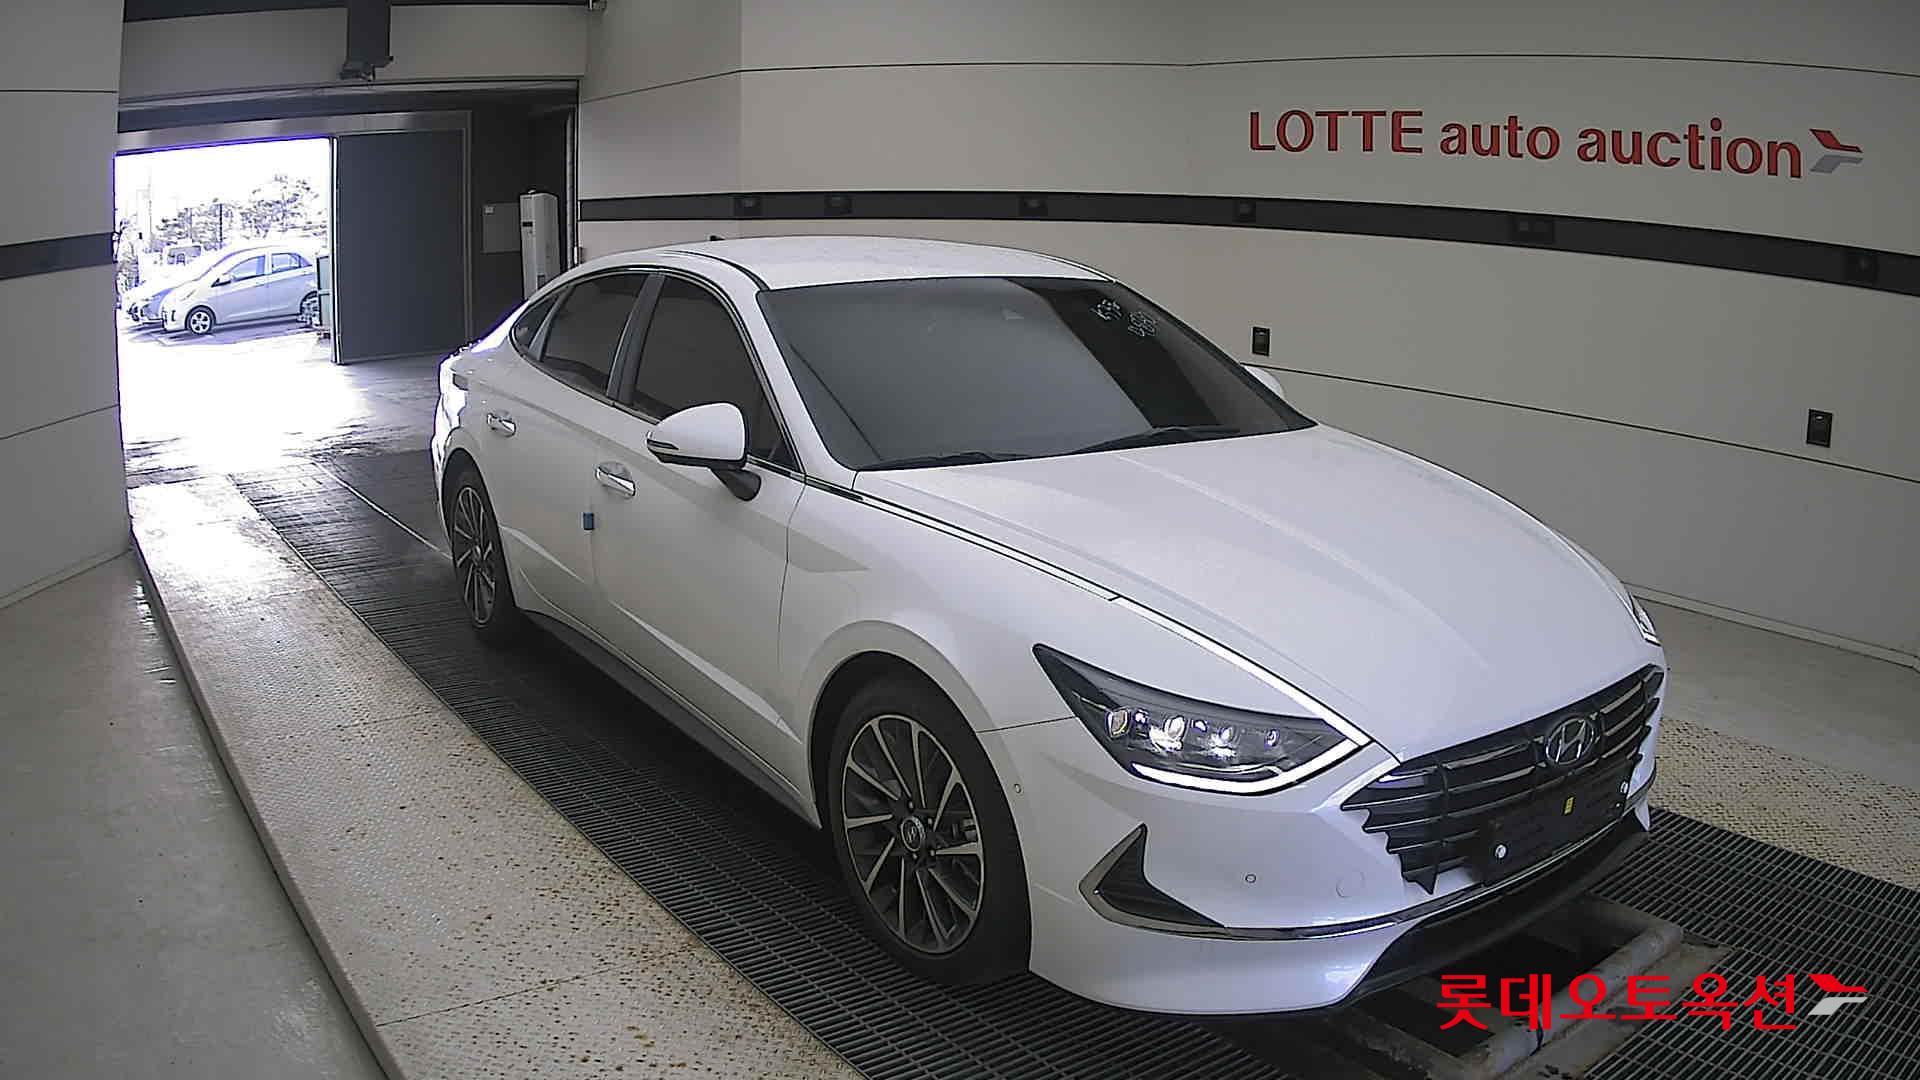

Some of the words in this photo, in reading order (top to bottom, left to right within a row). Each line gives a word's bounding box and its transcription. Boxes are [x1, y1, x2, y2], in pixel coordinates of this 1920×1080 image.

[1249, 110, 1424, 154] LOTTE
[1440, 116, 1561, 160] auto
[1576, 117, 1803, 179] auction
